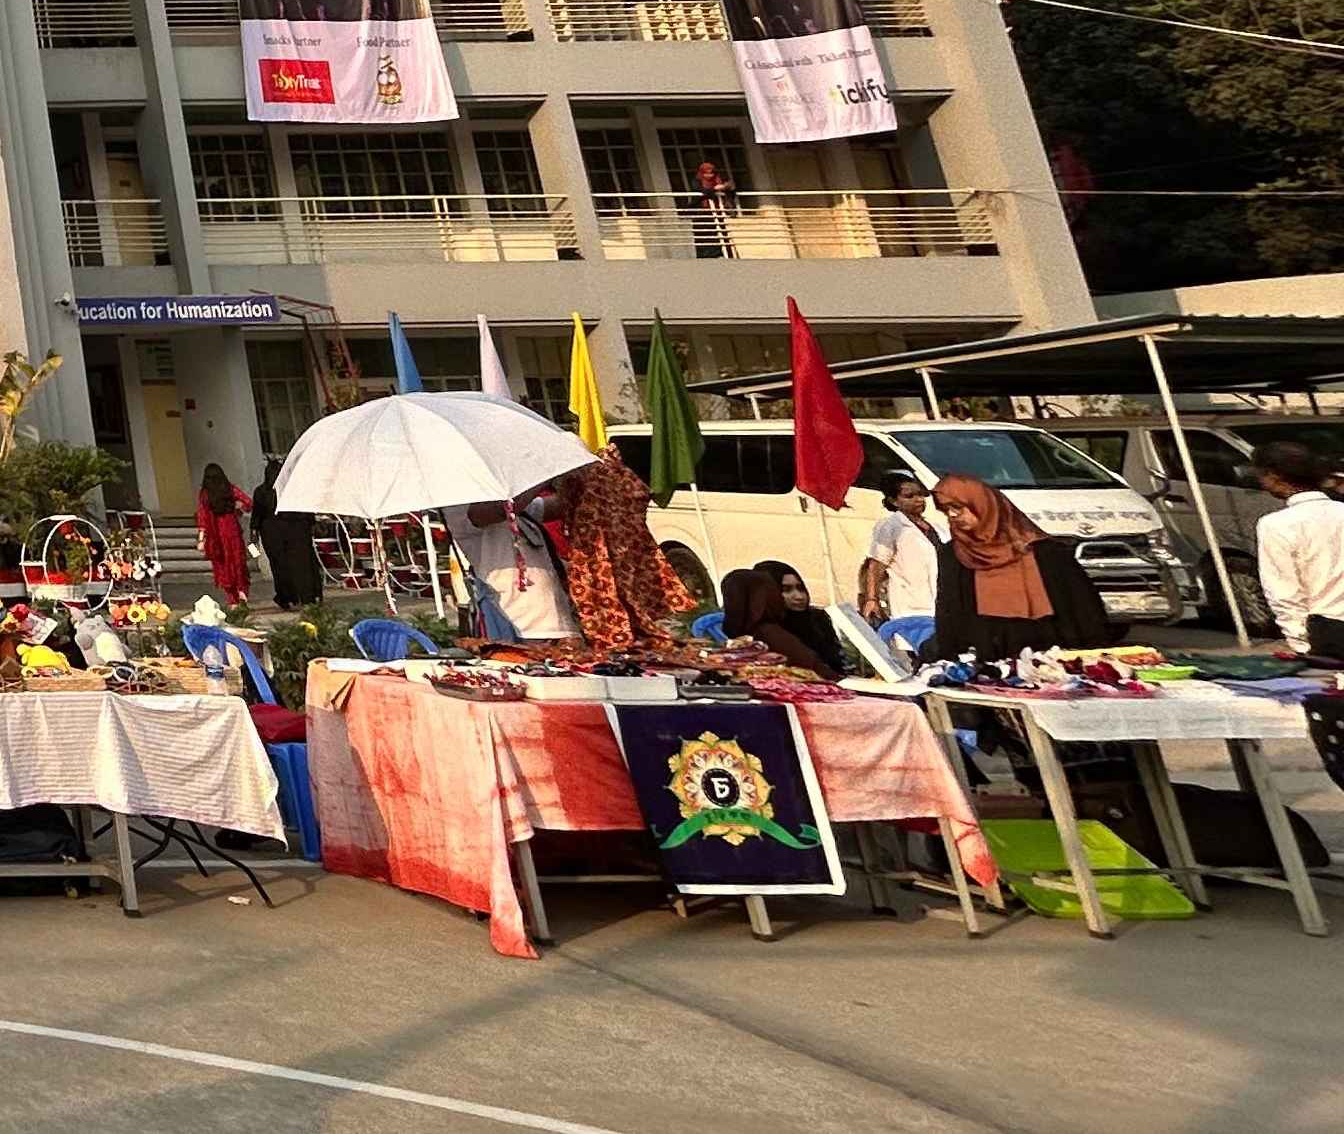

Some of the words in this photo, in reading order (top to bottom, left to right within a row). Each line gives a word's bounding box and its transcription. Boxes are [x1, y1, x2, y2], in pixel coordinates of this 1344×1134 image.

[78, 303, 136, 320] ucation
[140, 302, 162, 319] for
[166, 301, 273, 319] Humanization
